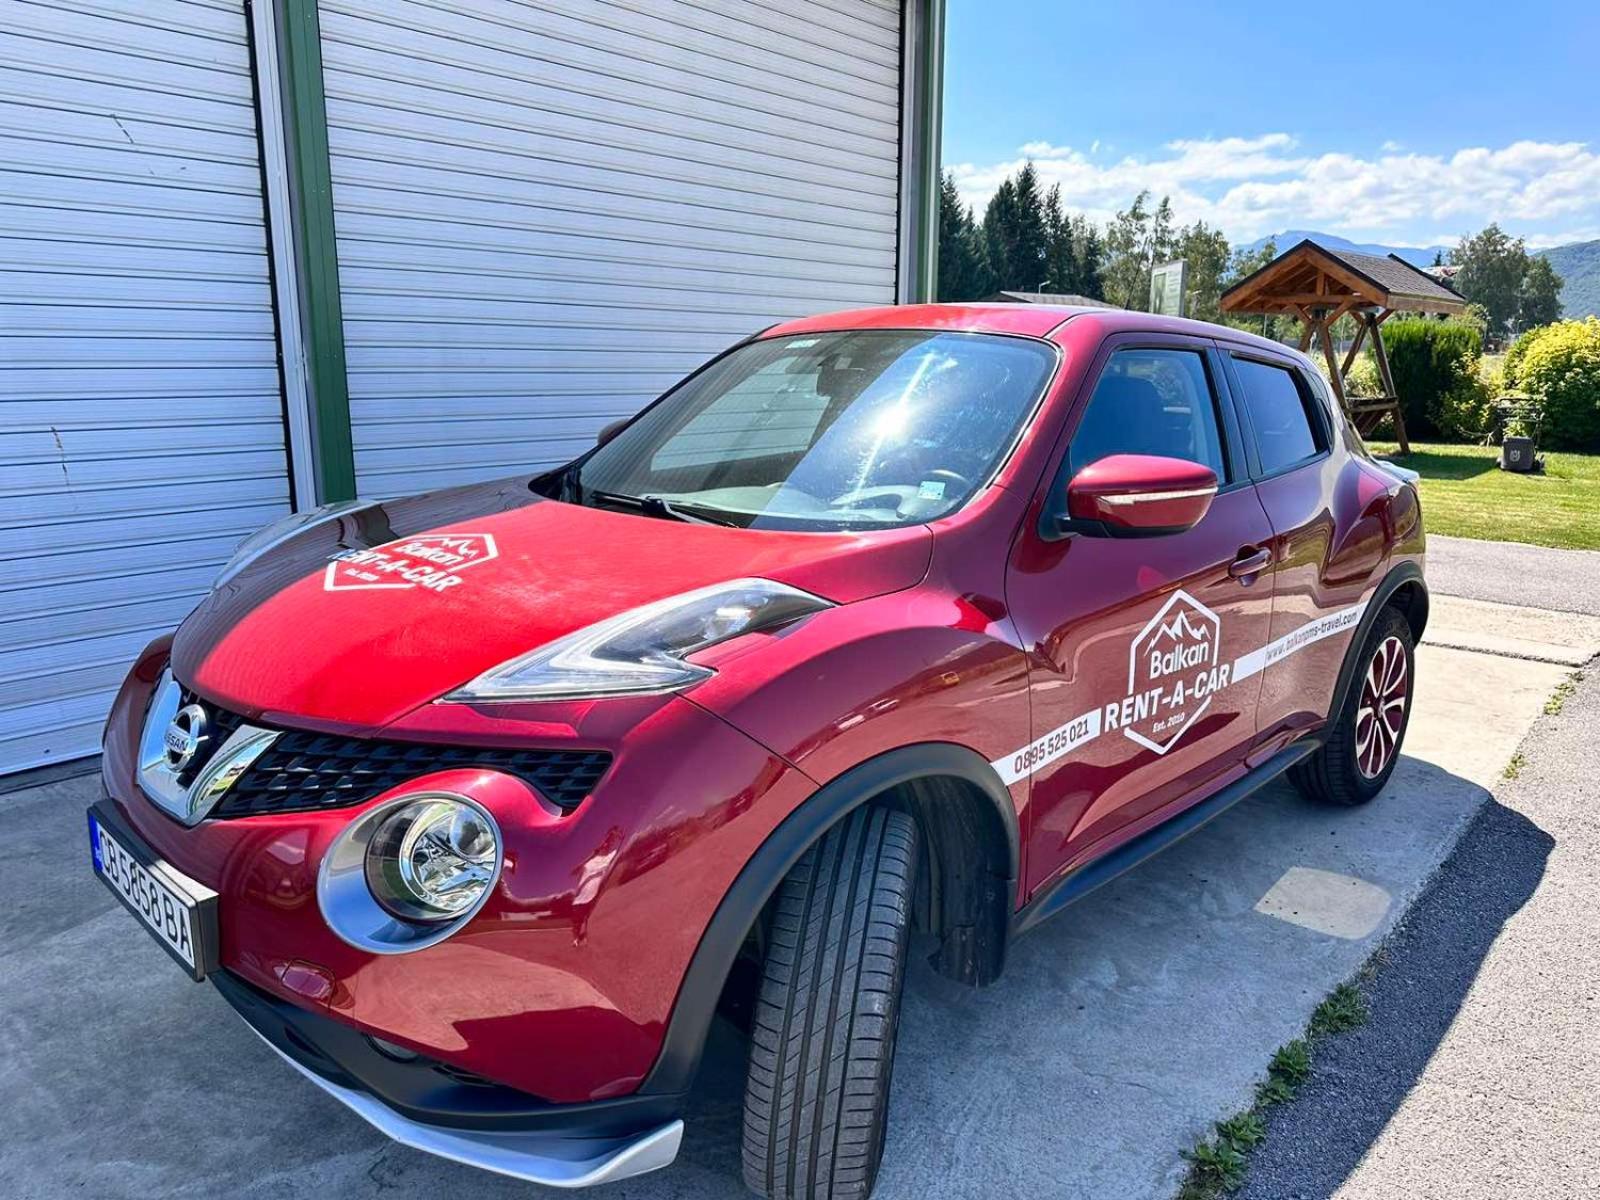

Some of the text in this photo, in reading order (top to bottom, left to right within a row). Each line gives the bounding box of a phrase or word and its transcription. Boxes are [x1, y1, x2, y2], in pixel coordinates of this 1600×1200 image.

[1150, 641, 1209, 679] Balkan
[1104, 663, 1230, 733] RENT-A-CAR
[1014, 718, 1089, 774] 0895 525 021
